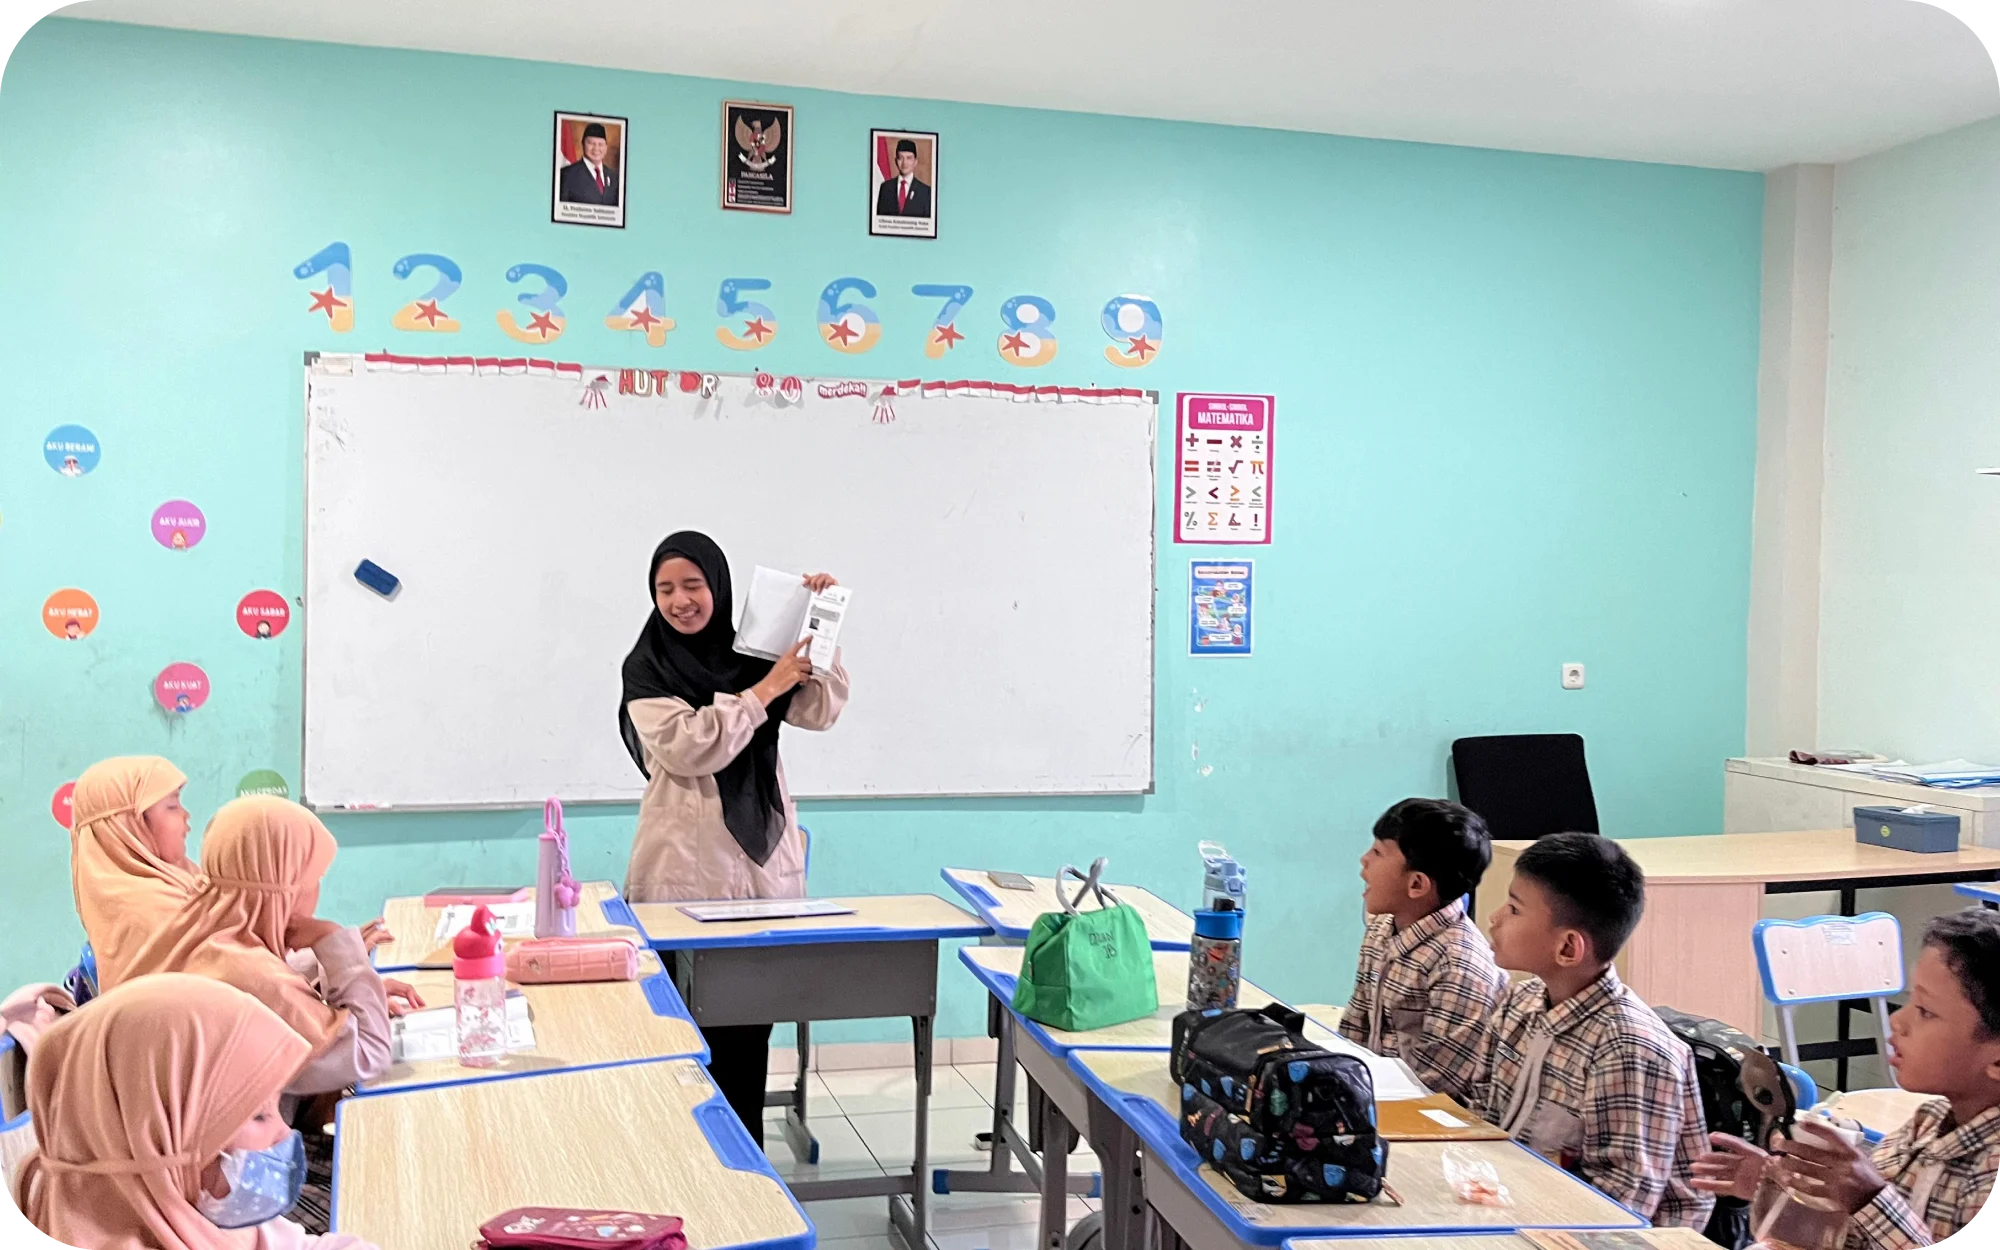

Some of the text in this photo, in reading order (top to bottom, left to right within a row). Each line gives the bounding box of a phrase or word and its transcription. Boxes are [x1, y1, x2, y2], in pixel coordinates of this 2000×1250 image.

[293, 241, 1163, 368] 1 2 3 4 5 6 7 8 9
[619, 368, 669, 396] HUT
[1197, 411, 1254, 426] MATEMATIKA
